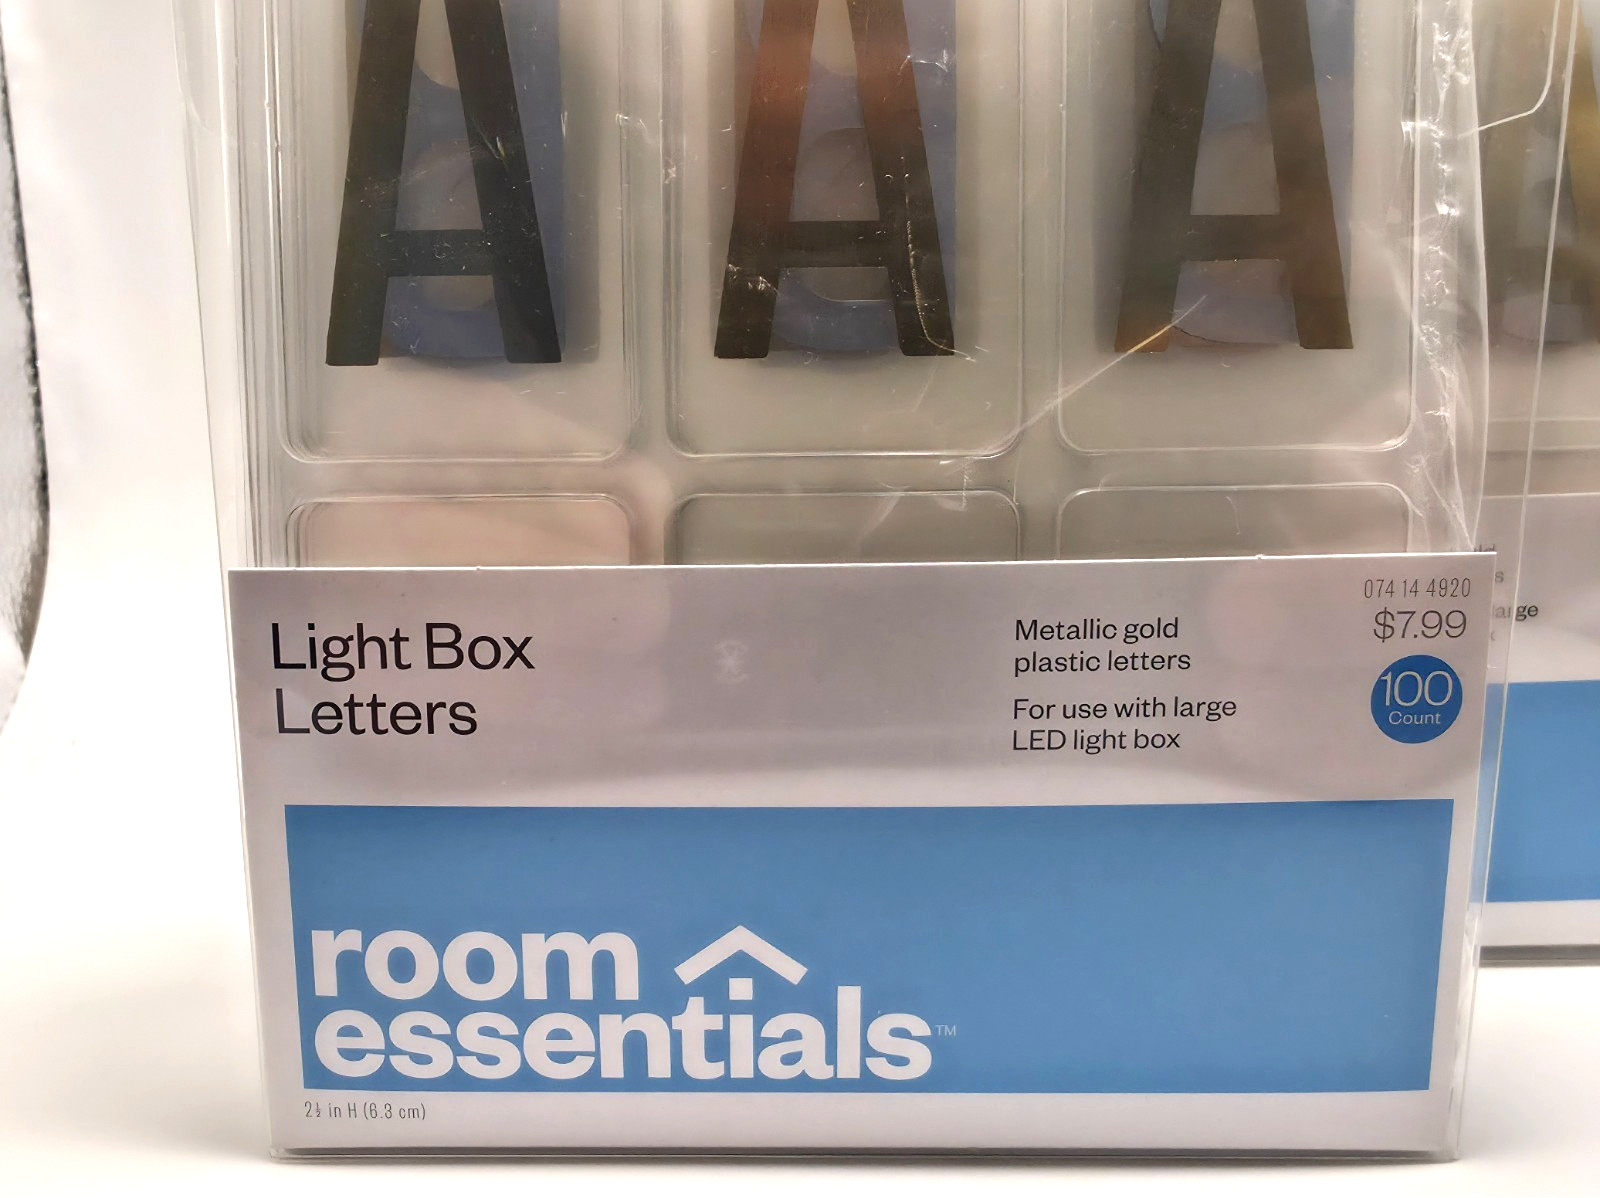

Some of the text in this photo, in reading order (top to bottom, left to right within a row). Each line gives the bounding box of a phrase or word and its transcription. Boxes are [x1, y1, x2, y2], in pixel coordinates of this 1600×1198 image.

[1363, 578, 1395, 599] 074
[1402, 578, 1419, 598] 14
[1426, 577, 1471, 598] 4920
[1015, 617, 1179, 645] Metallic gold
[1373, 606, 1467, 643] $7.99
[271, 622, 536, 683] Light Box
[1014, 650, 1191, 678] plastic letters
[1380, 670, 1453, 707] 100
[275, 688, 478, 736] Letters
[1013, 696, 1237, 722] For use with large
[1388, 711, 1441, 725] Count
[1012, 729, 1181, 755] LED light box
[311, 929, 639, 1001] room
[314, 977, 932, 1081] essentials
[328, 1103, 342, 1118] in
[347, 1102, 357, 1118] H
[363, 1102, 393, 1120] (6.3
[398, 1103, 426, 1120] cm)
